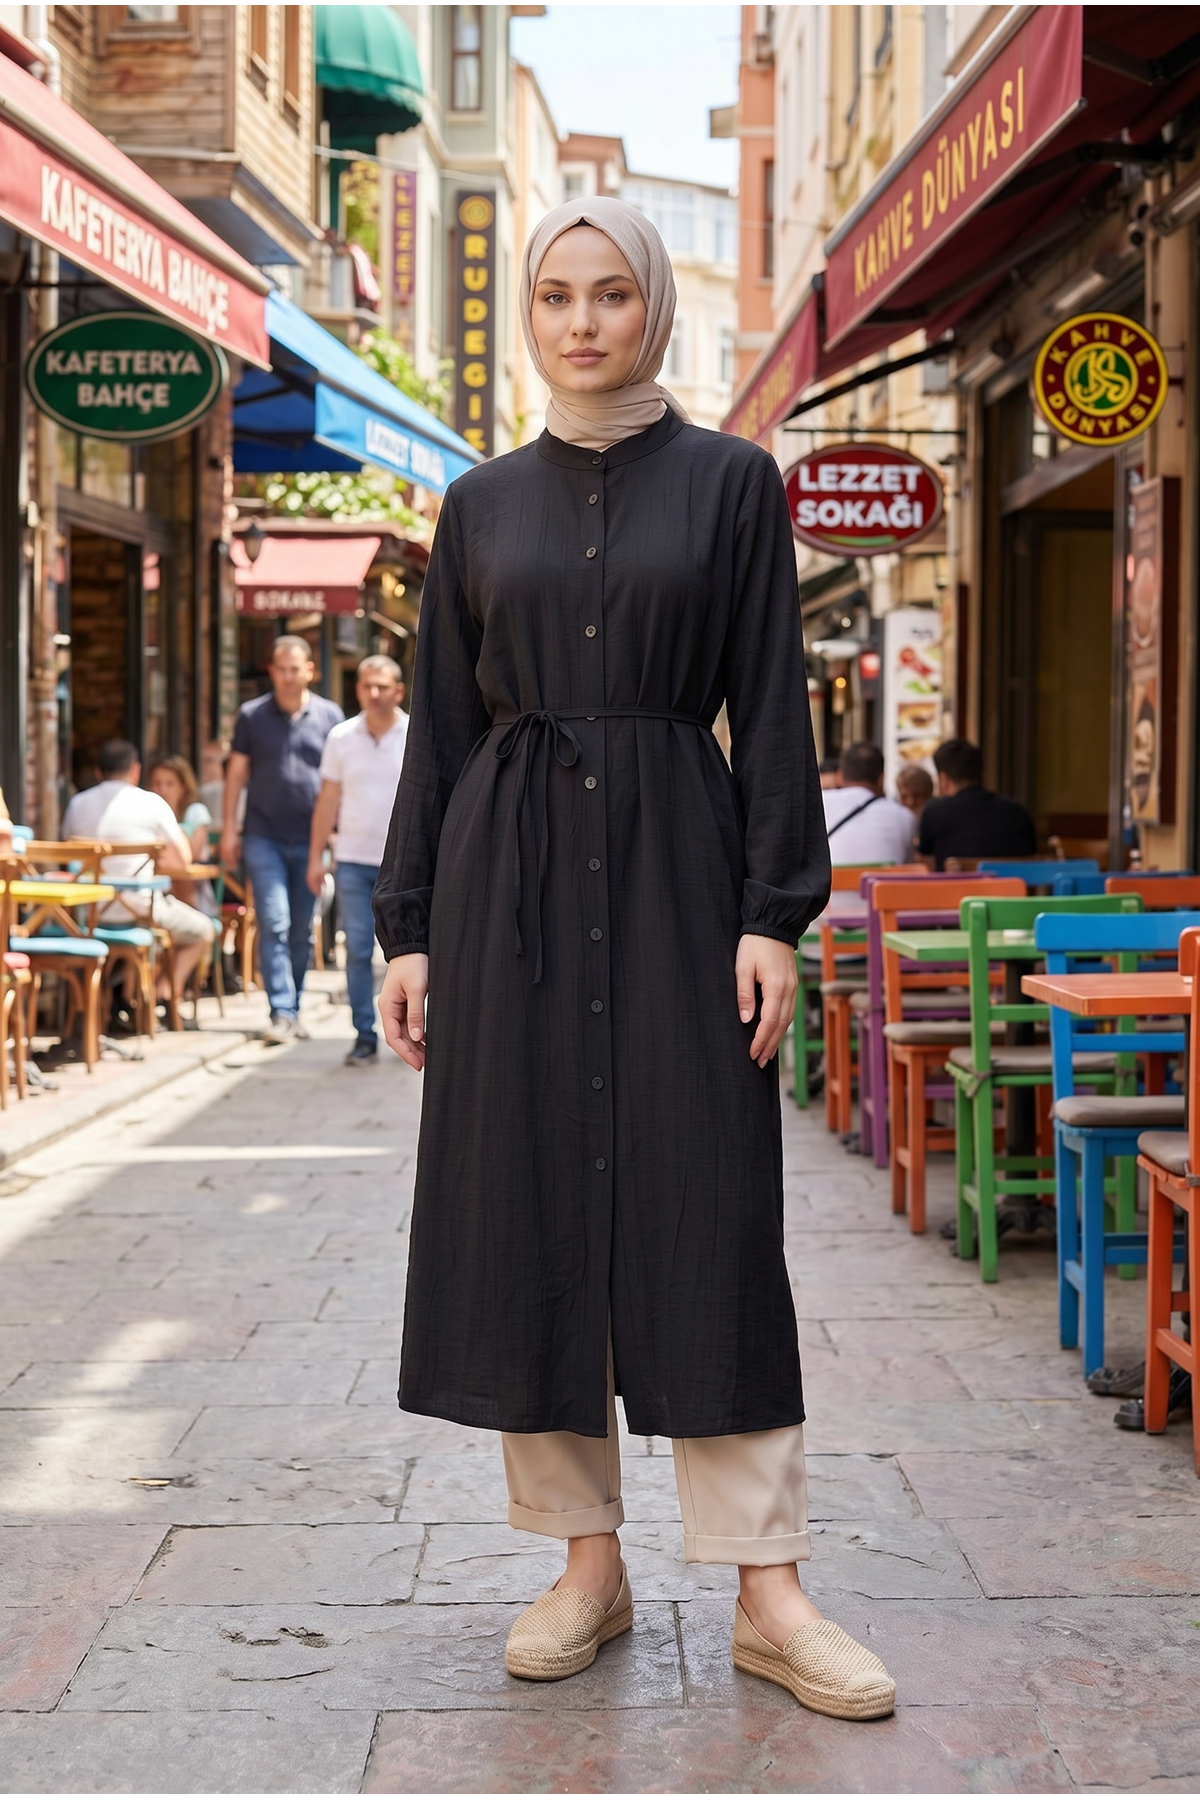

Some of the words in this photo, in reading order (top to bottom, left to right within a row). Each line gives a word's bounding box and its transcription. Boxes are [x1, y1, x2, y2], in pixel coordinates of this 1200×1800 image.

[854, 189, 914, 298] KAHVE
[921, 66, 1025, 231] DÜNYASI
[41, 164, 166, 294] KAFETERYA
[167, 248, 230, 334] BAHÇE
[45, 350, 202, 375] KAFETERYA
[1048, 322, 1154, 367] KAHVE
[76, 382, 171, 414] BAHÇE
[797, 463, 923, 493] LEZZET
[795, 493, 924, 529] SOKAĞI
